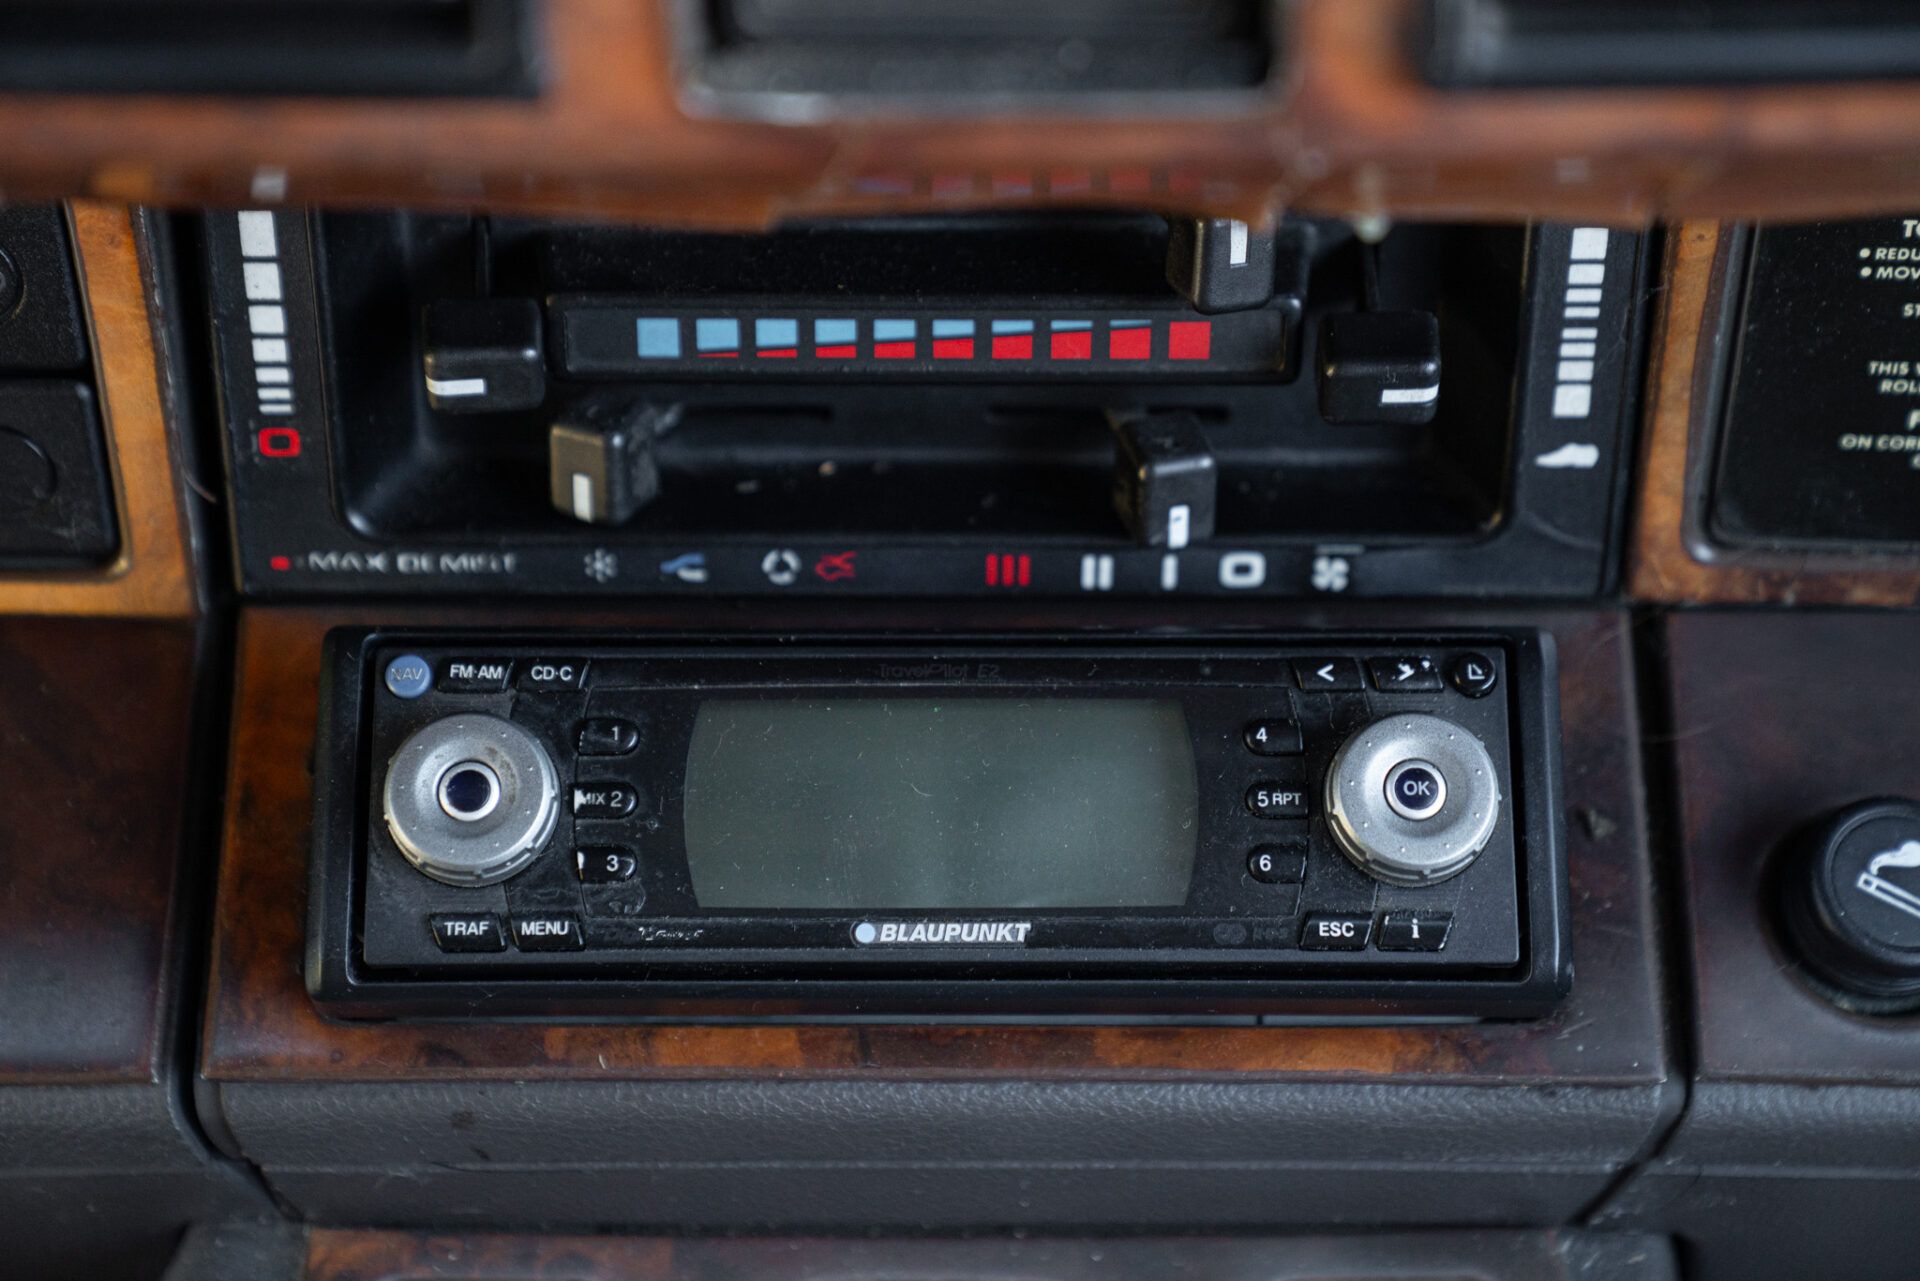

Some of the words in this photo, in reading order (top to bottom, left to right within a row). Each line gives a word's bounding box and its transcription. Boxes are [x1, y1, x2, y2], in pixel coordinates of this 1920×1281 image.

[1903, 219, 1920, 238] T
[1869, 361, 1909, 376] THIS
[1840, 434, 1872, 451] ON
[390, 667, 423, 681] NAV
[611, 726, 619, 741] 1
[1256, 727, 1268, 743] 4
[1403, 780, 1430, 797] OK
[610, 791, 622, 808] 2
[1257, 792, 1269, 808] 5
[1272, 793, 1301, 806] RPT
[606, 855, 619, 872] 3
[1259, 856, 1272, 872] 6
[444, 921, 489, 937] TRAF
[521, 921, 569, 937] MENU
[879, 922, 1031, 943] BLAUPUNKT
[1318, 922, 1355, 938] ESC
